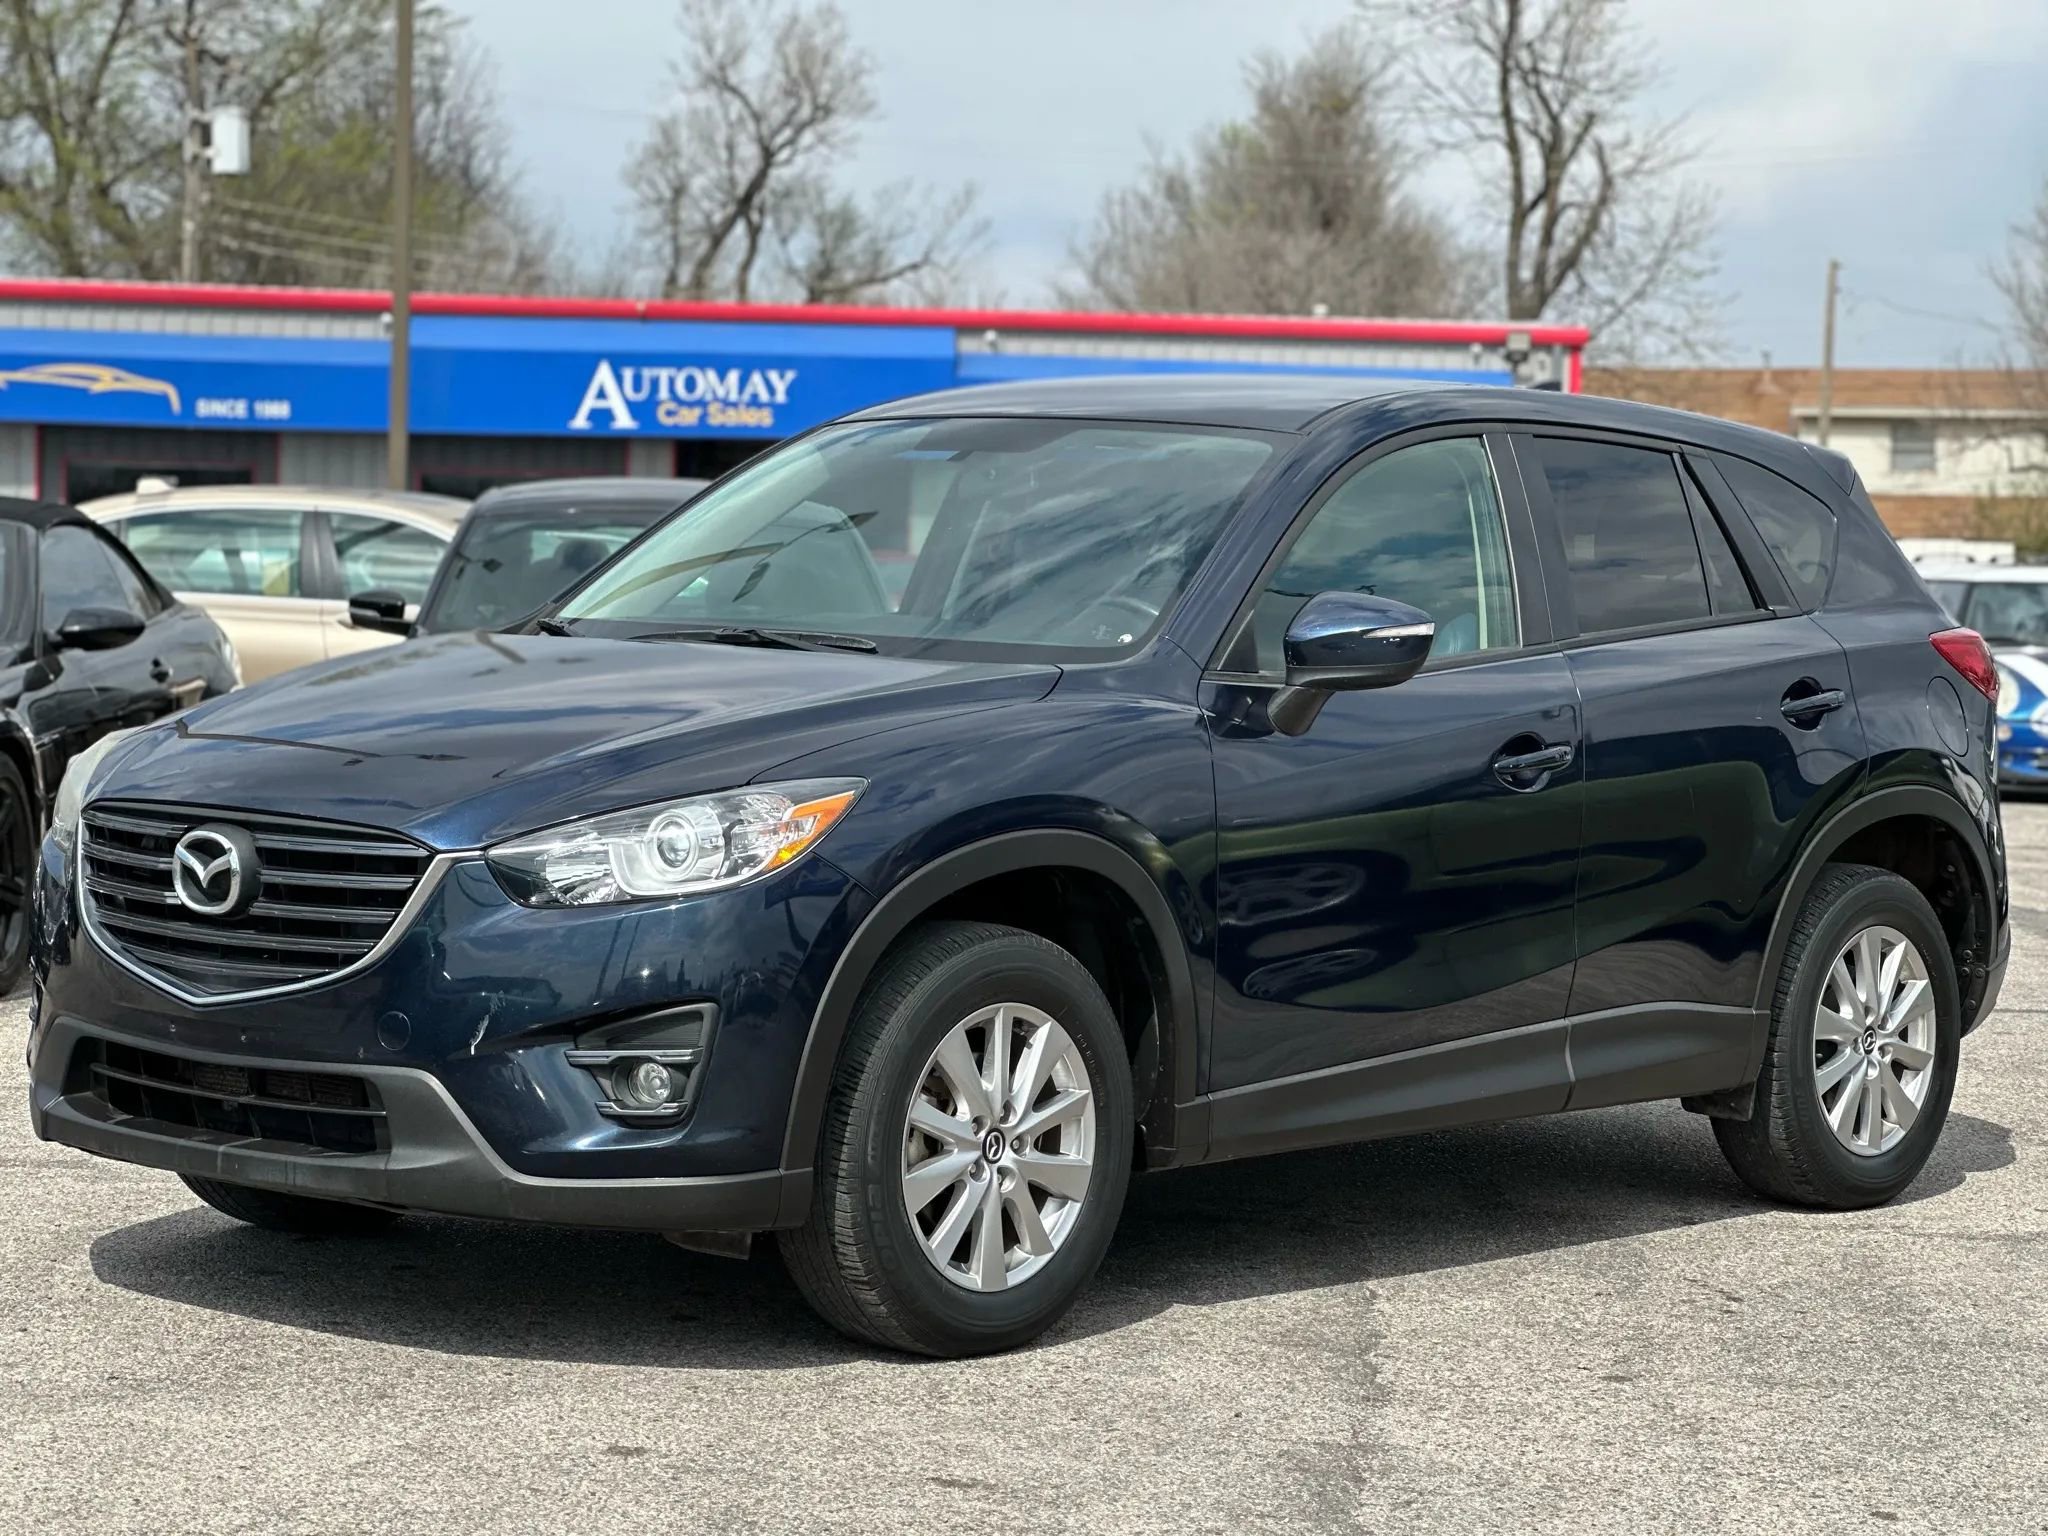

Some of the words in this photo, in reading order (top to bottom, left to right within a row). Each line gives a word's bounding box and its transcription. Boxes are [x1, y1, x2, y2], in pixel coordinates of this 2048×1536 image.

[195, 398, 247, 418] SINCE
[568, 359, 796, 430] AUTOMAY
[656, 401, 701, 427] Car
[706, 402, 773, 428] Sales
